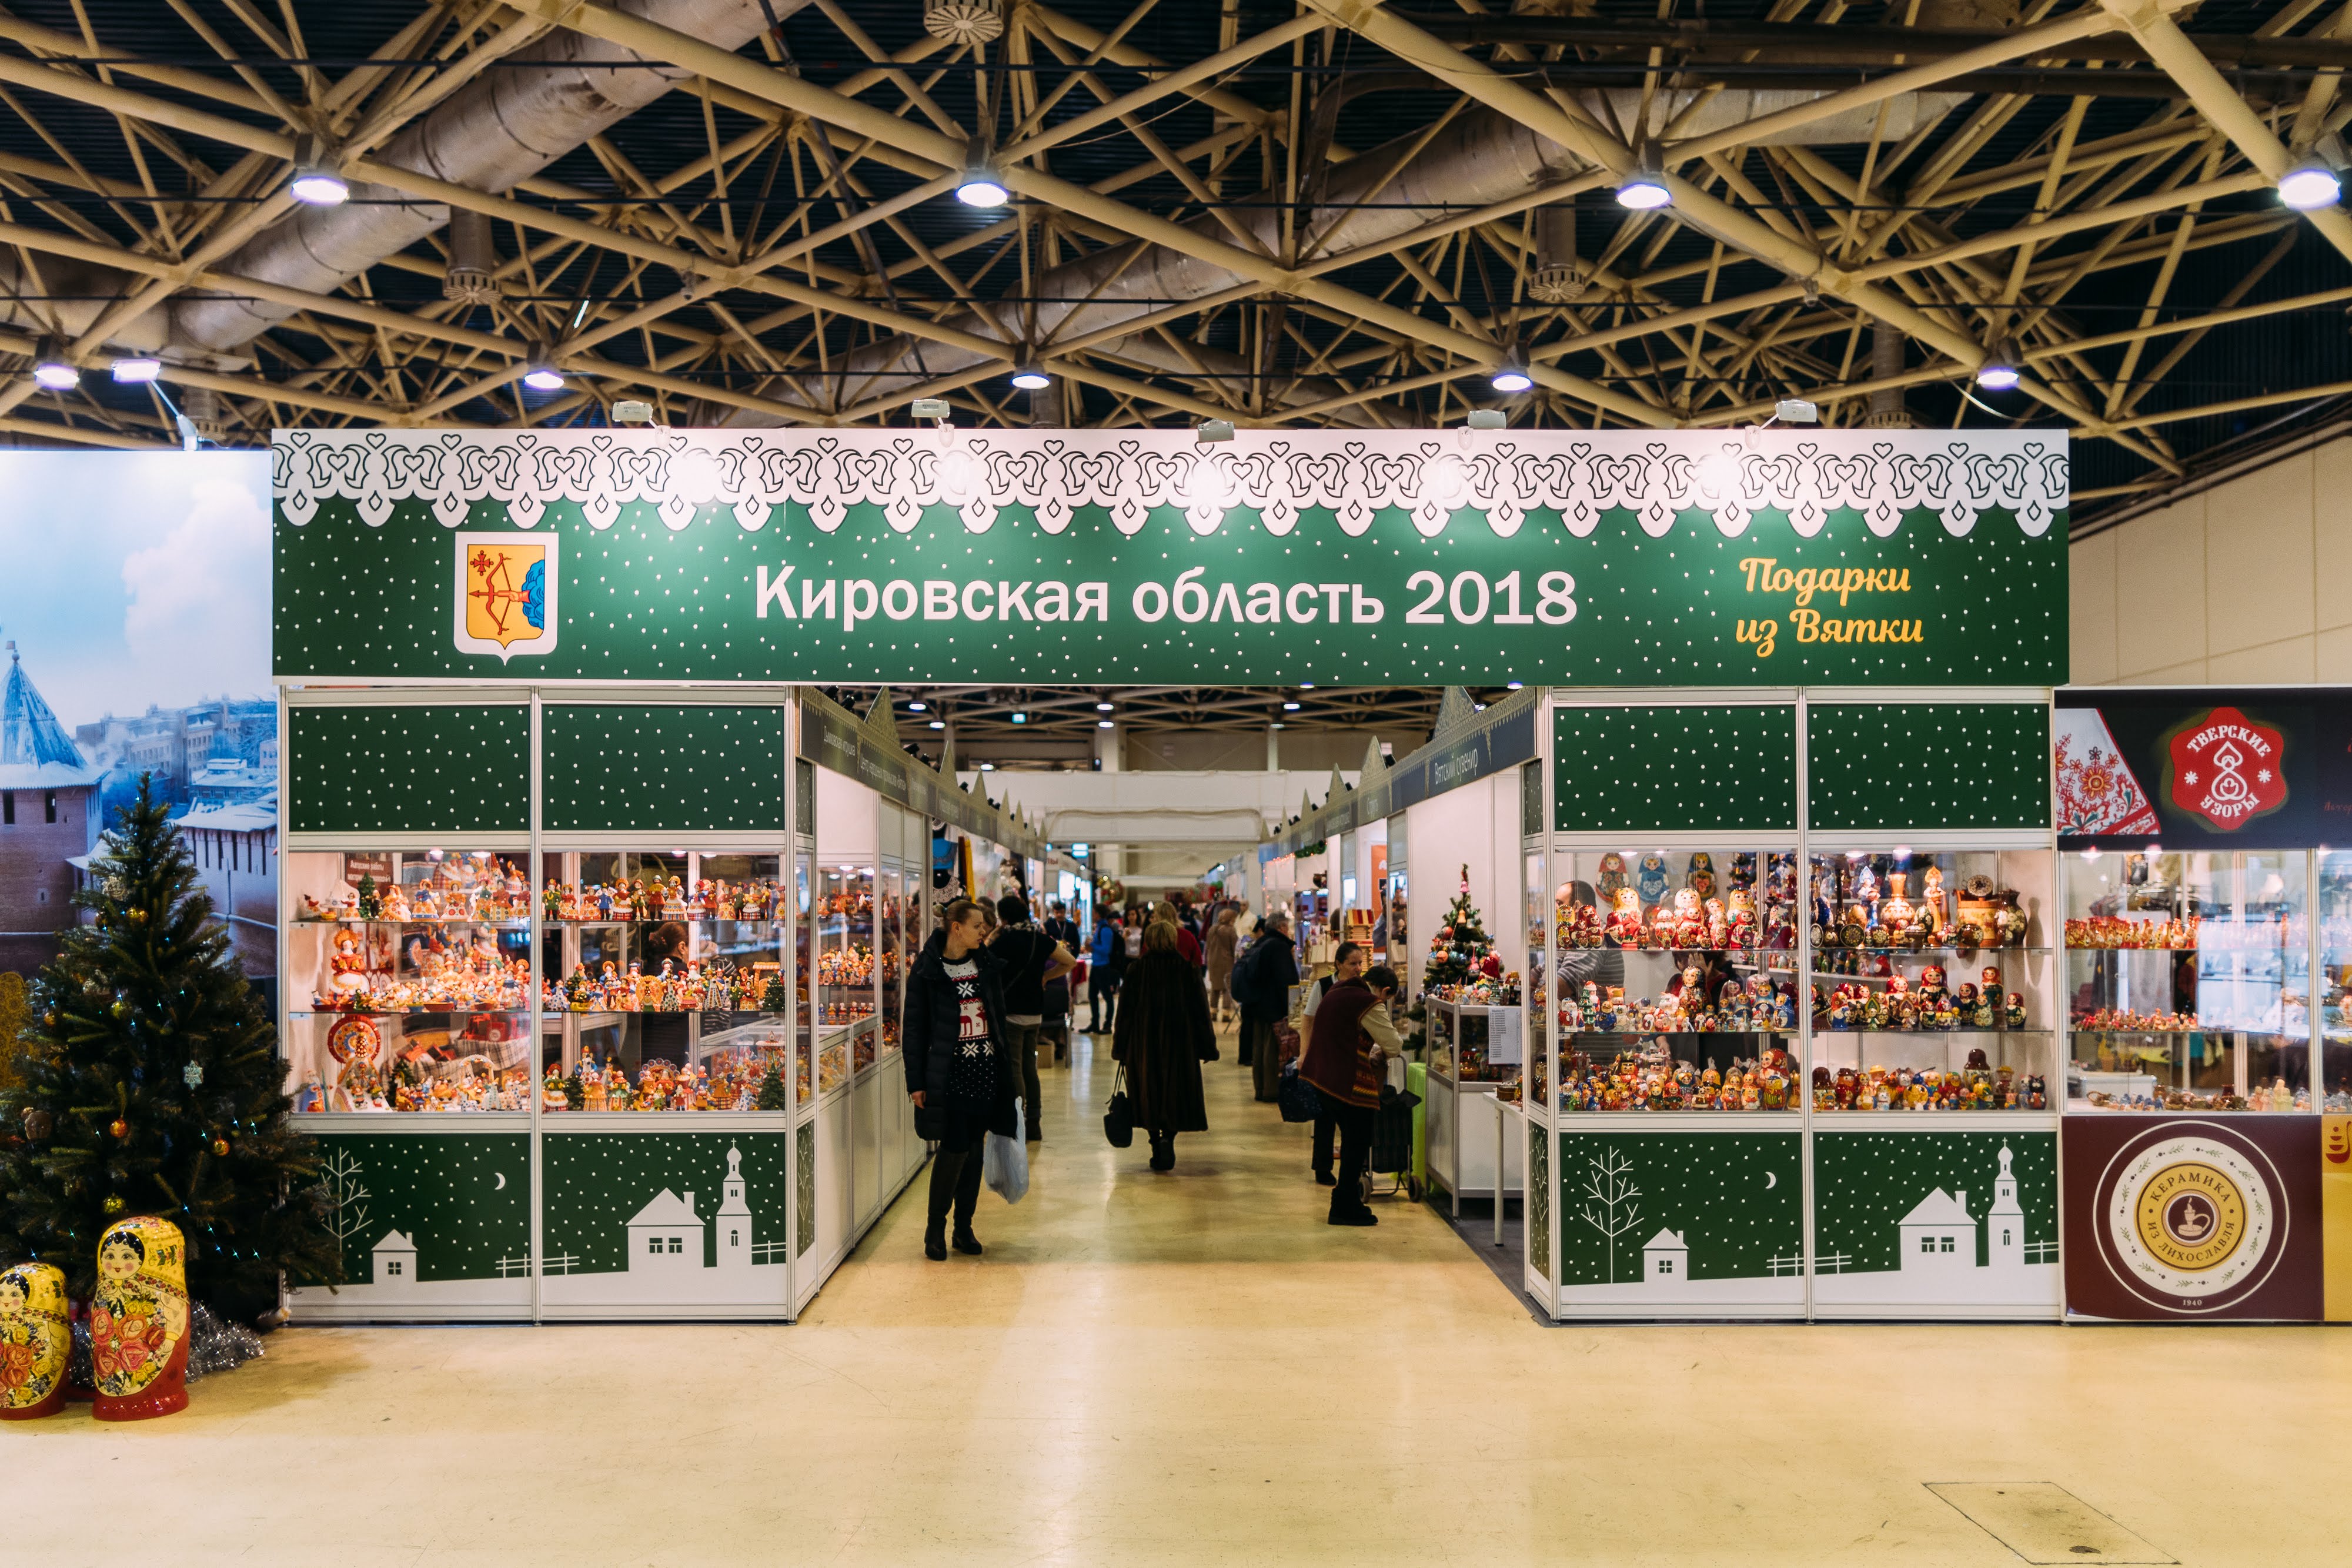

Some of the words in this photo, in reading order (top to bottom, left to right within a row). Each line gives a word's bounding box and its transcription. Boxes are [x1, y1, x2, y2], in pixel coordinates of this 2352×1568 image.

[756, 564, 1108, 632] Кировская
[1131, 566, 1385, 624] область
[1405, 570, 1578, 626] 2018
[1738, 557, 1912, 607] Подарки
[1735, 619, 1779, 658] из
[1789, 608, 1925, 643] Вятки
[2186, 724, 2272, 758] ТВЕРСКИЕ
[1435, 753, 1455, 785] Вятский
[1456, 748, 1478, 781] сувенир
[2199, 791, 2261, 818] УЗОРЫ
[2150, 1172, 2231, 1202] КЕРАМИКА
[2147, 1221, 2160, 1239] ИЗ
[2158, 1222, 2235, 1262] ЛИХОСЛАВЛЯ
